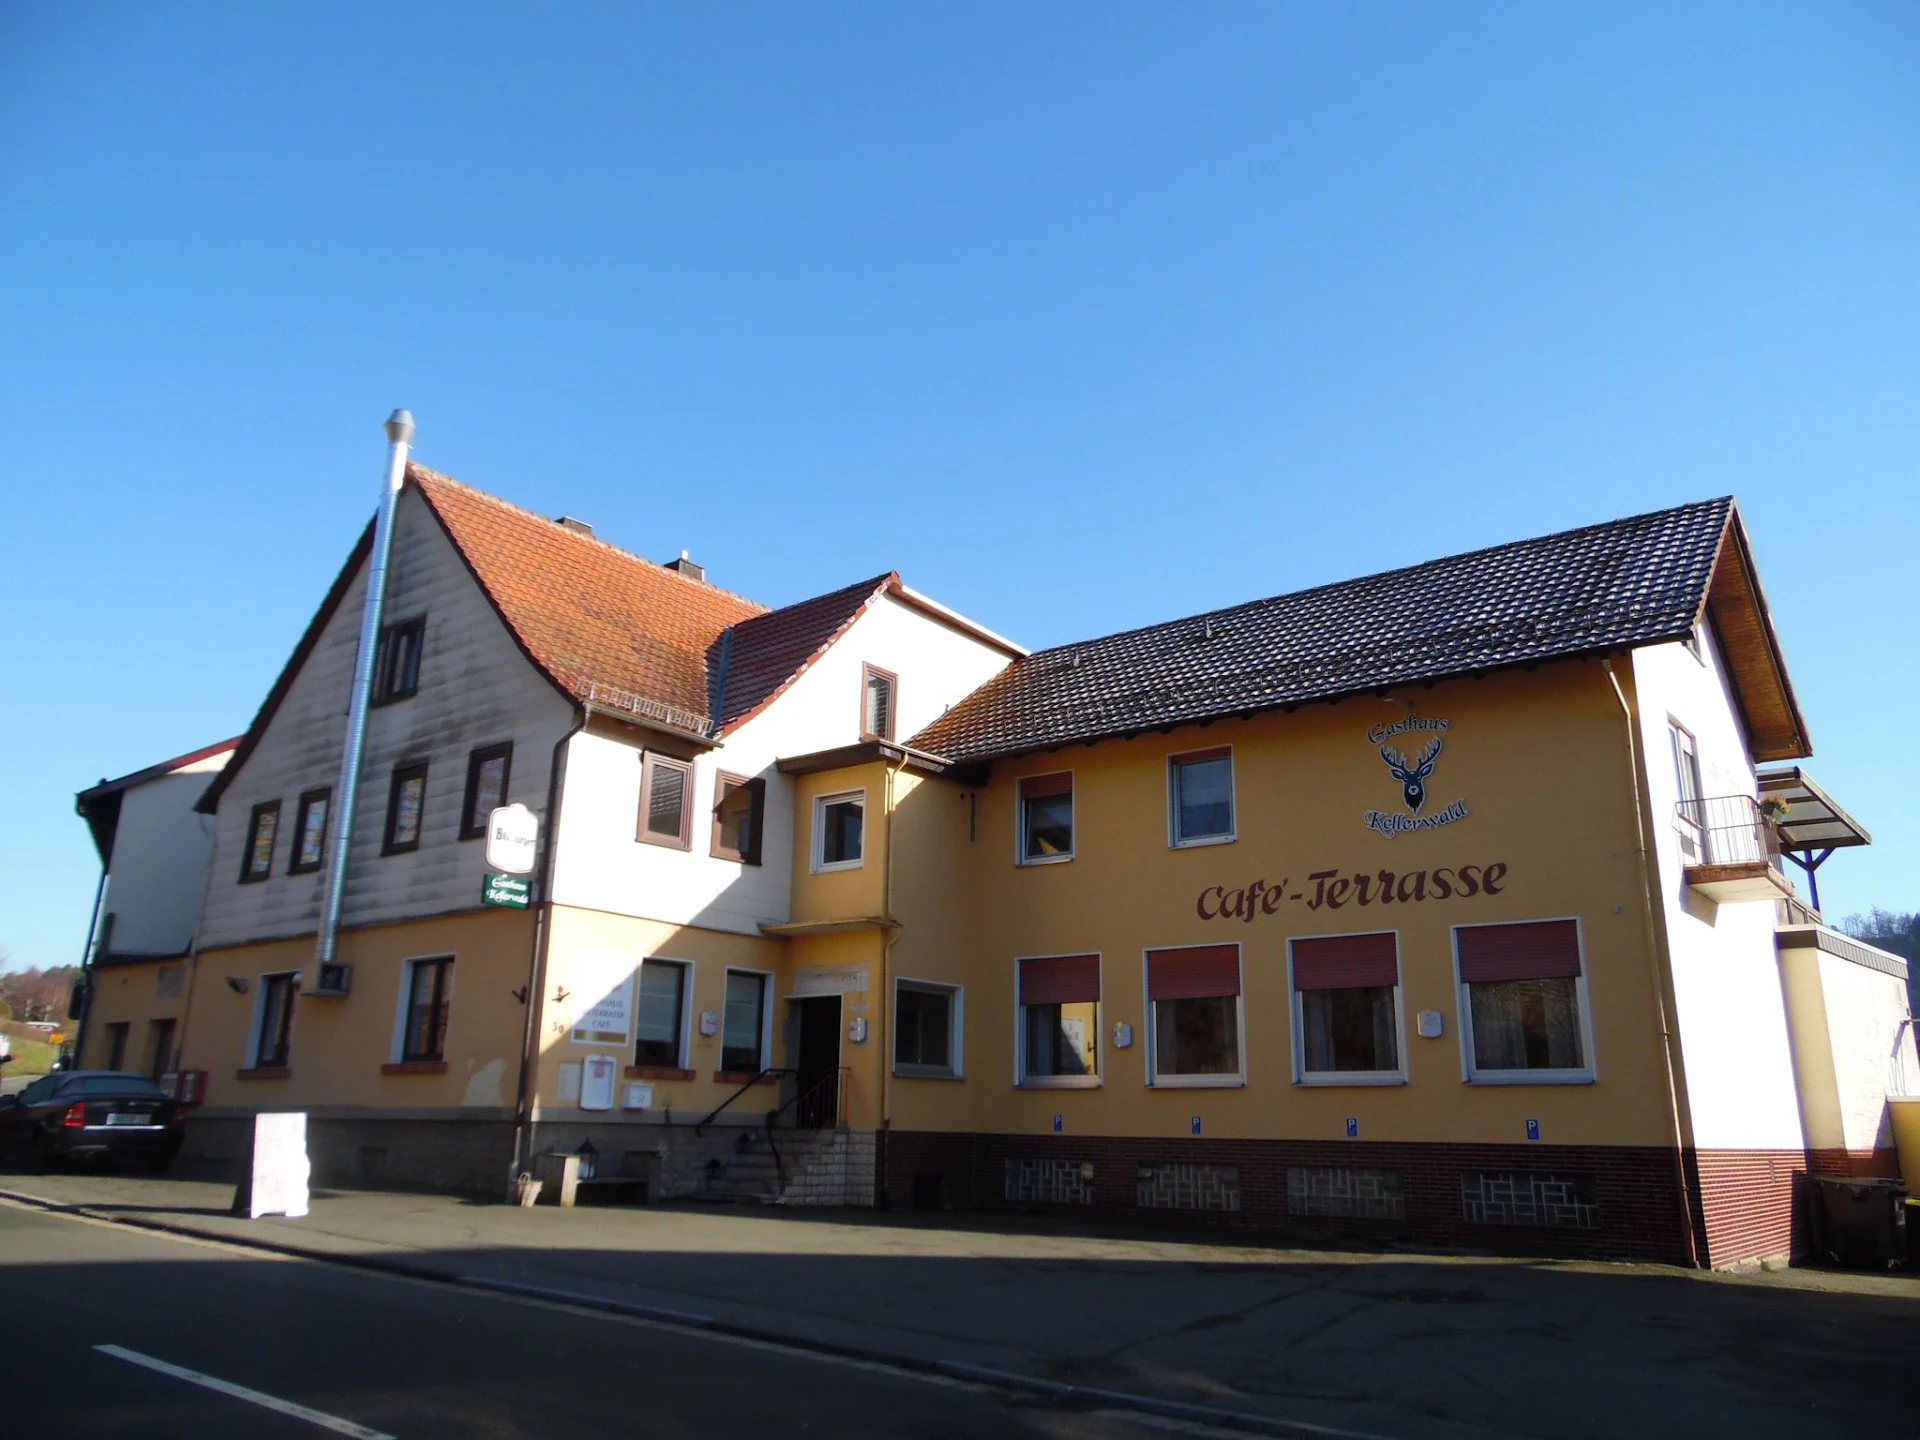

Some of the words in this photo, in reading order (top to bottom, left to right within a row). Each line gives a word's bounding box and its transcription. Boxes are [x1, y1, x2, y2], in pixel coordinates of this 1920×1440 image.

[1367, 713, 1449, 745] Gasthaus
[1364, 797, 1467, 839] Kellerwald
[492, 874, 527, 891] Gasthaus
[486, 889, 529, 904] Kellerwald
[1193, 1117, 1199, 1125] P
[1348, 1119, 1356, 1128] P
[1528, 1121, 1536, 1130] P
